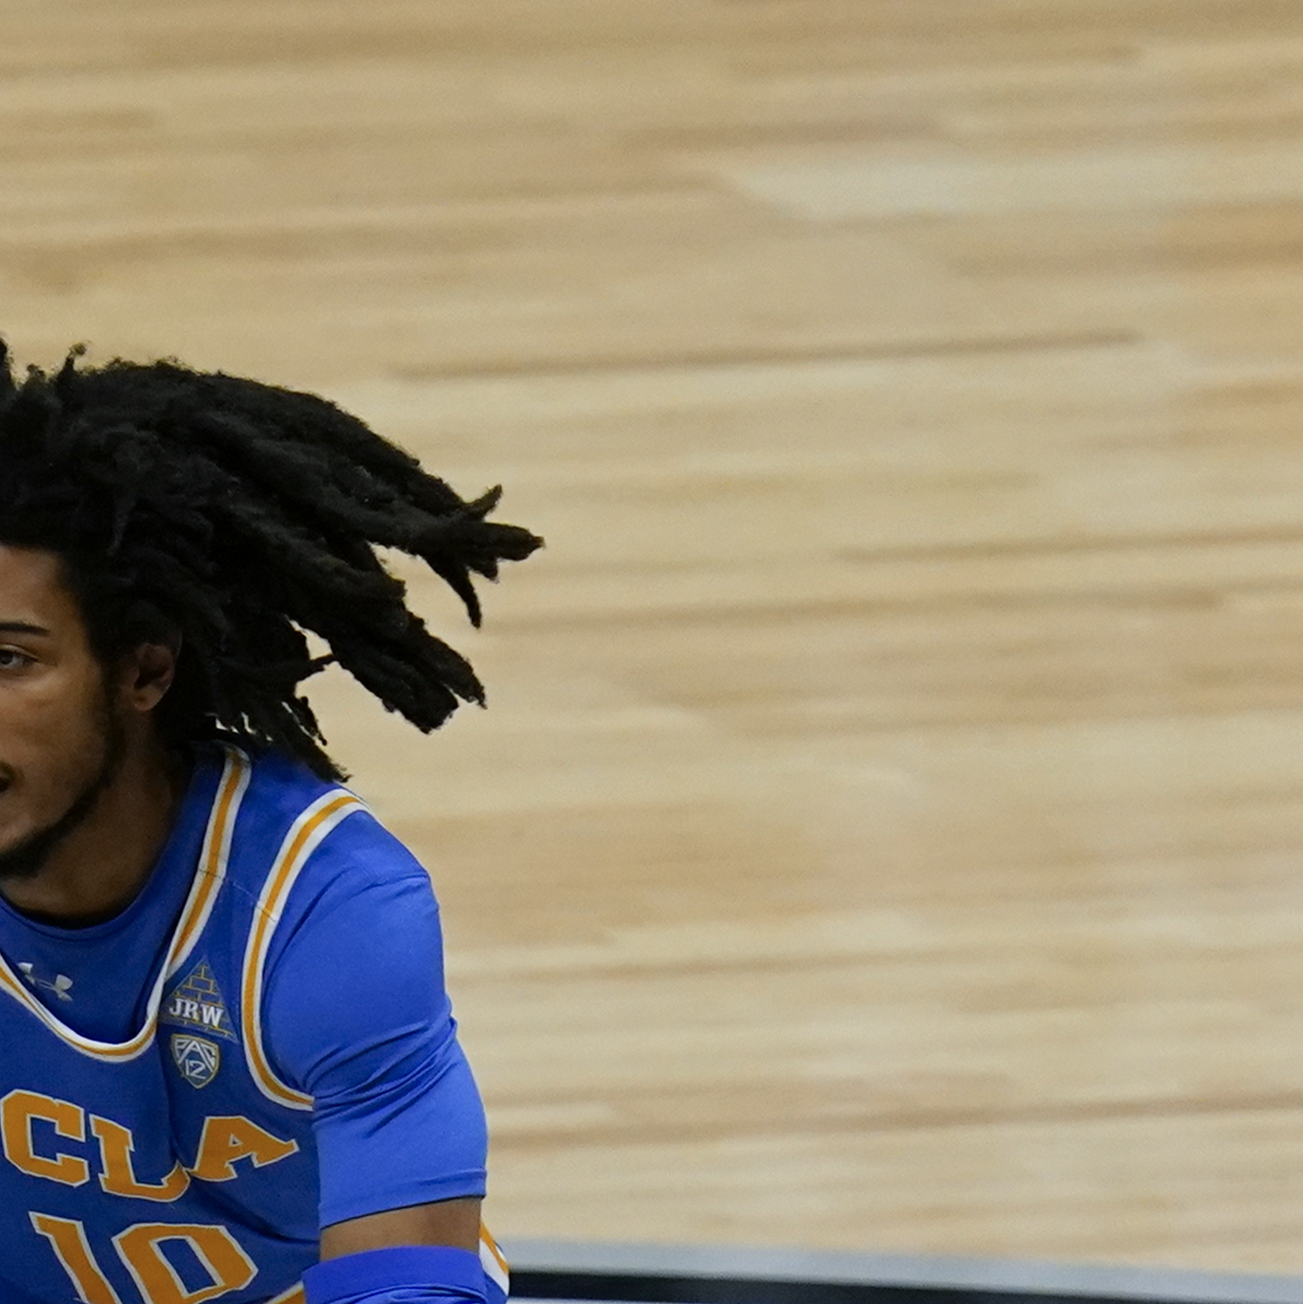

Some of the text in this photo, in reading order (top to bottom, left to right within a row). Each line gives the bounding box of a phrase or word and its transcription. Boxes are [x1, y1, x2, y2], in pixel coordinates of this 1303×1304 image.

[169, 998, 224, 1028] JRW
[173, 1038, 217, 1074] PAC
[184, 1058, 207, 1080] 12
